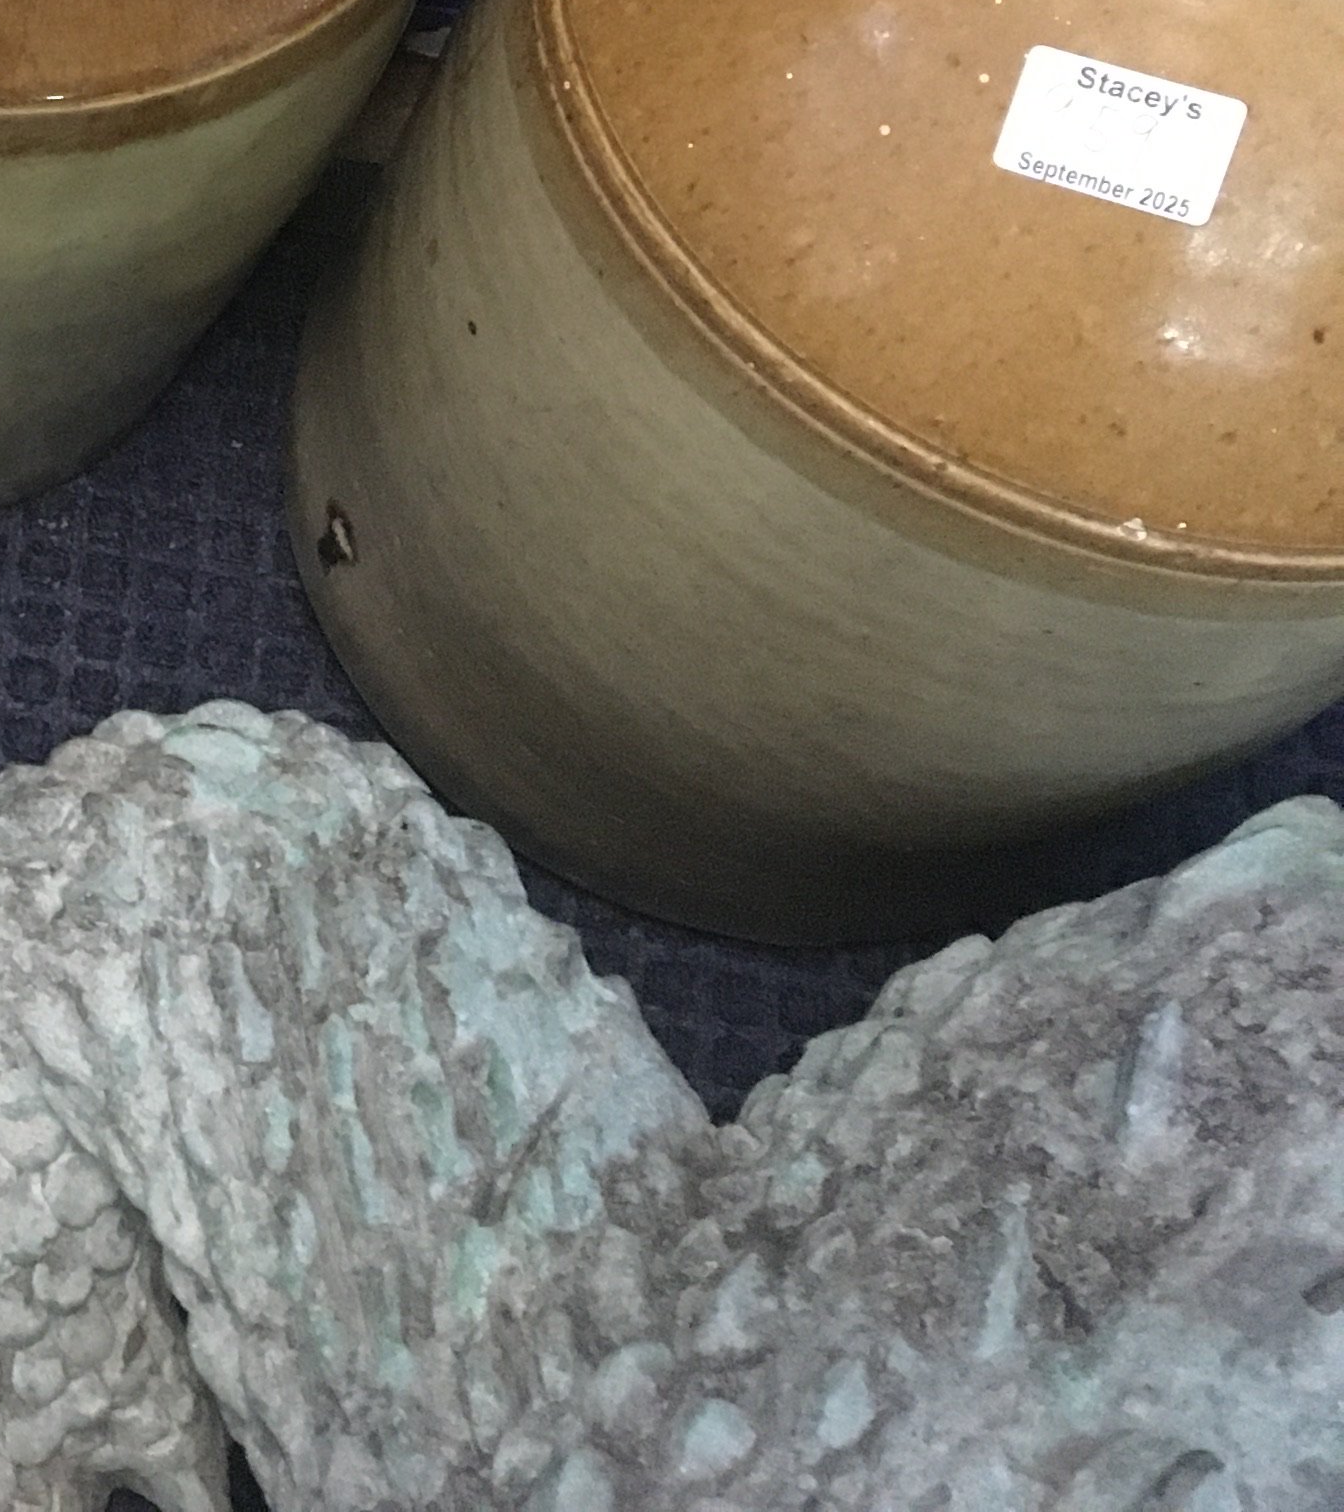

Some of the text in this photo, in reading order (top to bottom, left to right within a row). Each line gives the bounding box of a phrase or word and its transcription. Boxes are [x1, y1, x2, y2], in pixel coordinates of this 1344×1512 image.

[1076, 65, 1203, 121] Stacey's
[1017, 151, 1191, 218] September 2025
